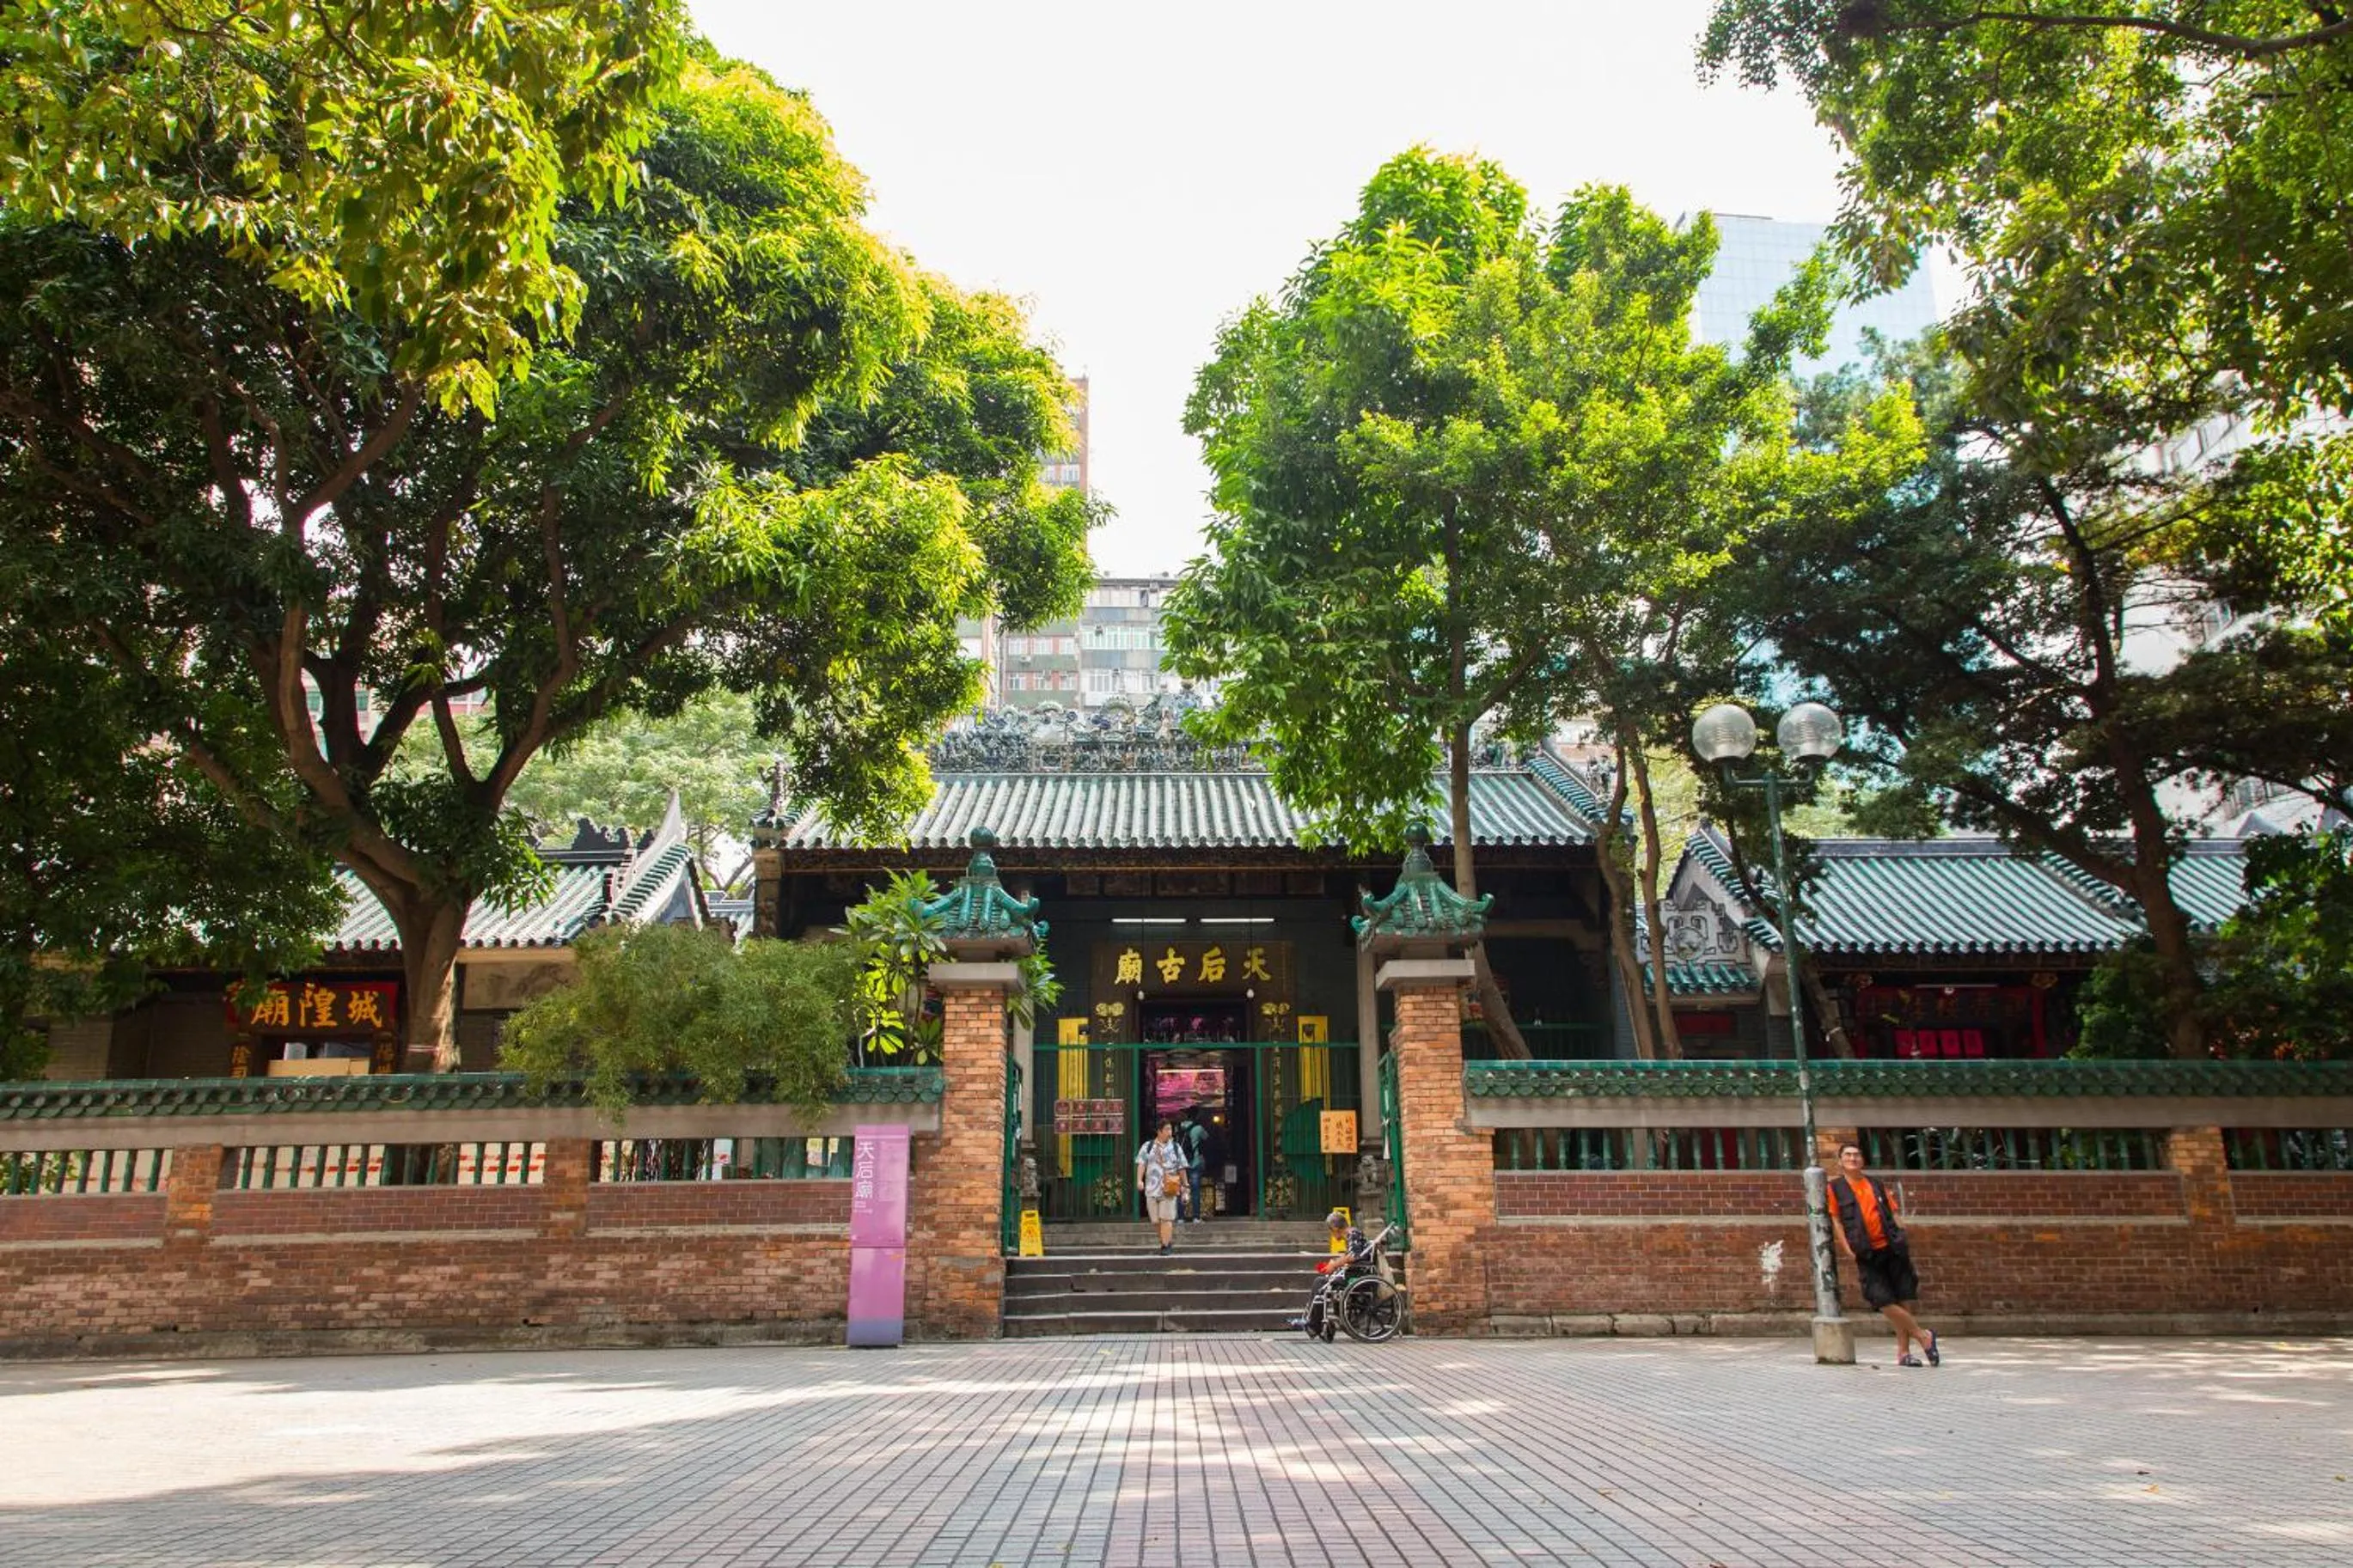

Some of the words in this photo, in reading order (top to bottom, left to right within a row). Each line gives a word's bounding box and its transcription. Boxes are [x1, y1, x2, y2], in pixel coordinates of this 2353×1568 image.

[1114, 946, 1272, 985] 天后古廟
[250, 983, 383, 1028] 城隍廟
[856, 1141, 875, 1199] 天后廟
